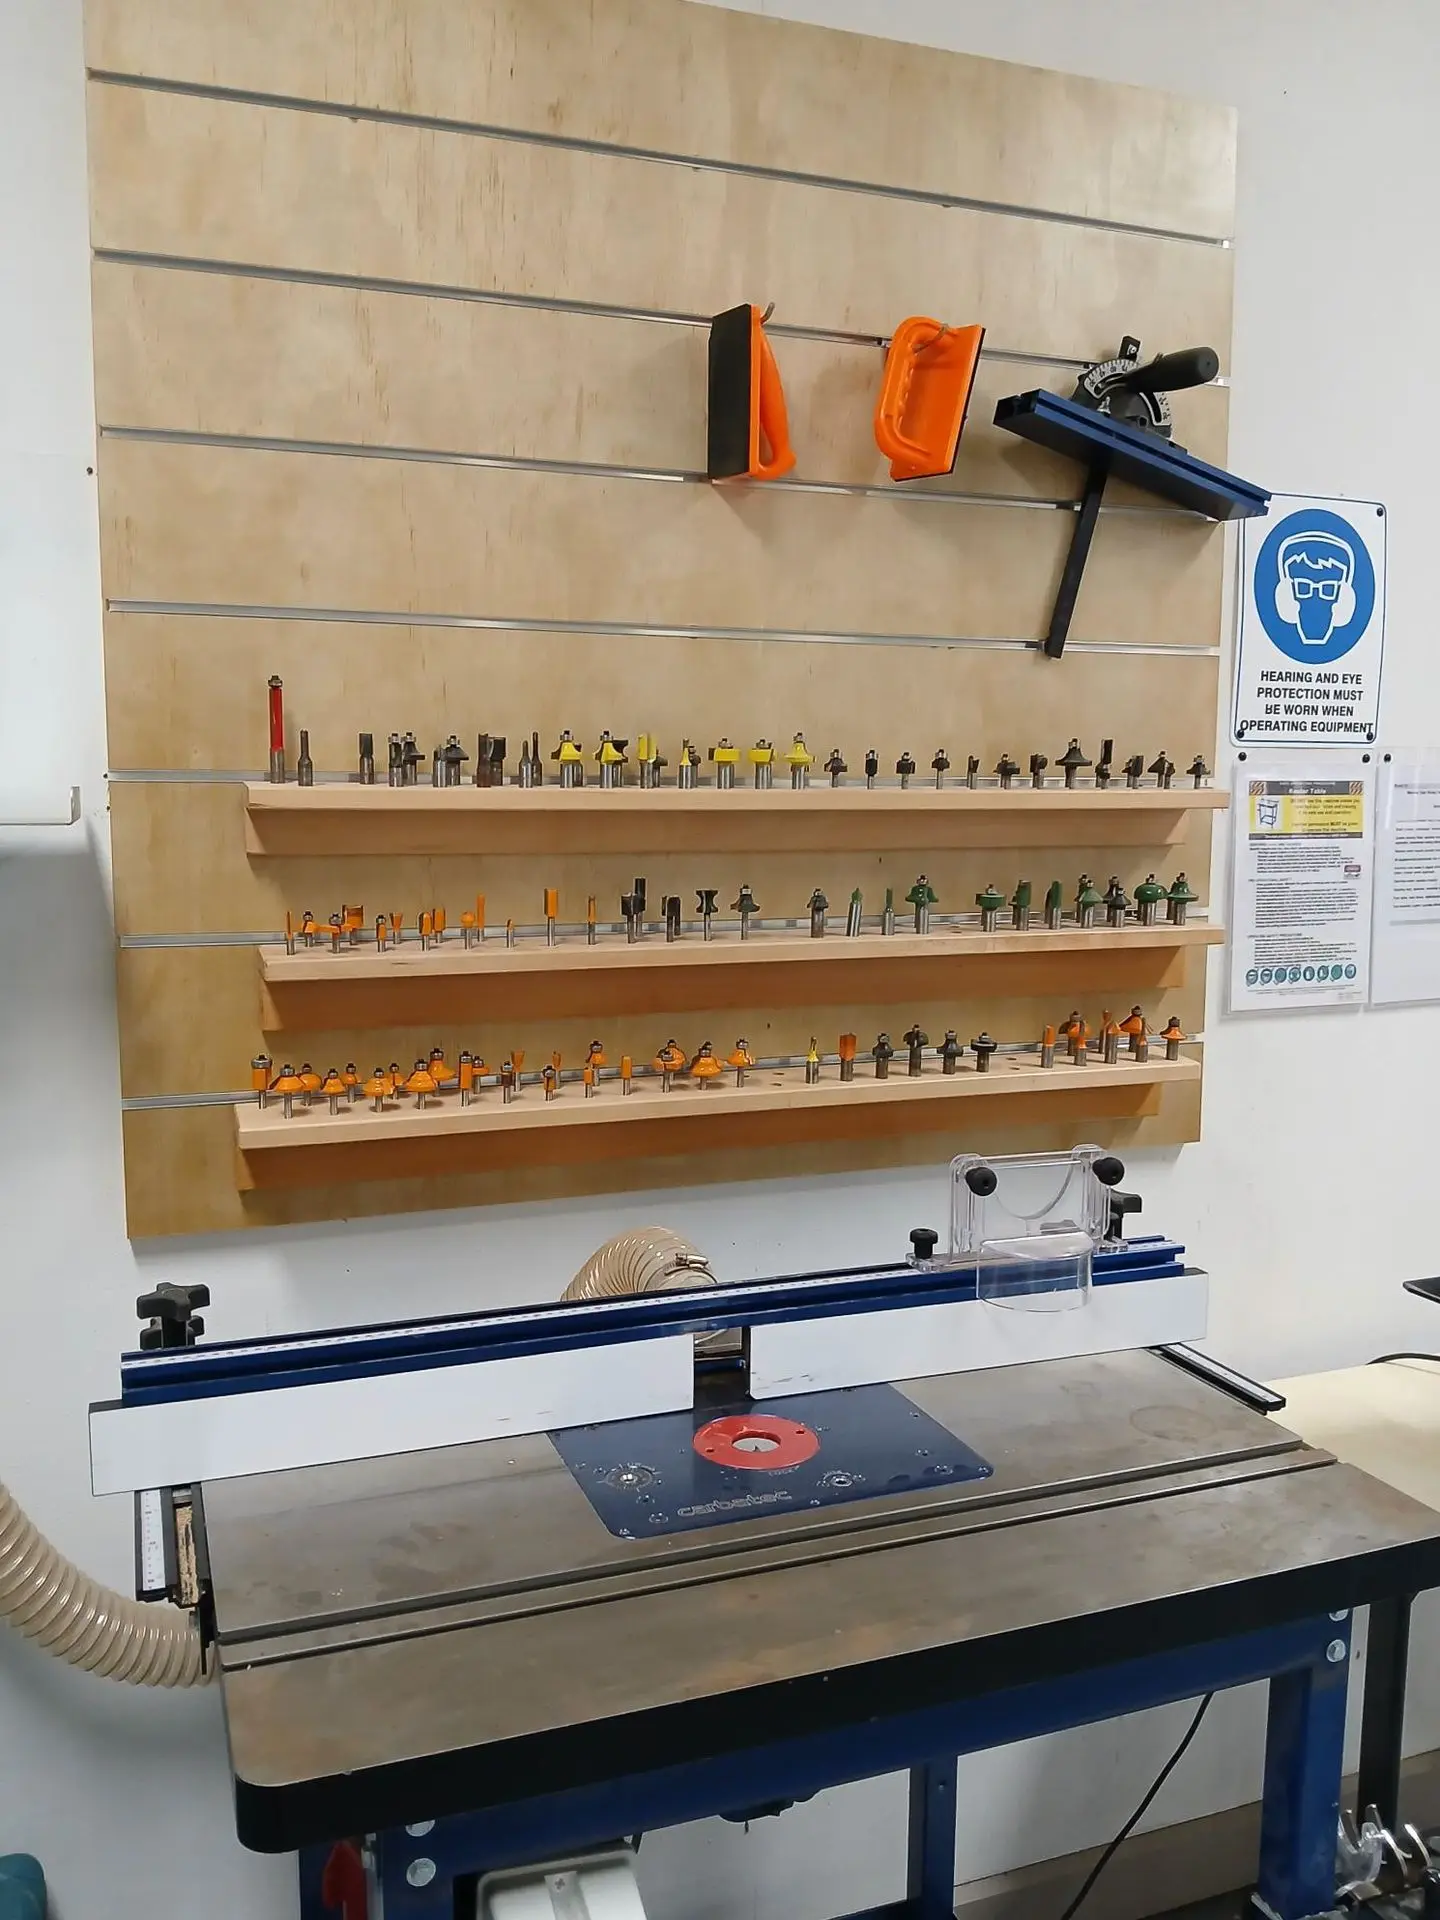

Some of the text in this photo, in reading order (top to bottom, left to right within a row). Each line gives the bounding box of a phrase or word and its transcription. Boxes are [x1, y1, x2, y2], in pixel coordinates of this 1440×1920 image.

[1260, 670, 1362, 685] HEARING AND EYE
[1257, 687, 1364, 701] PROTECTION MUST
[1265, 704, 1354, 716] BE WORN WHEN
[1240, 720, 1374, 733] OPERATING EQUIPMENT
